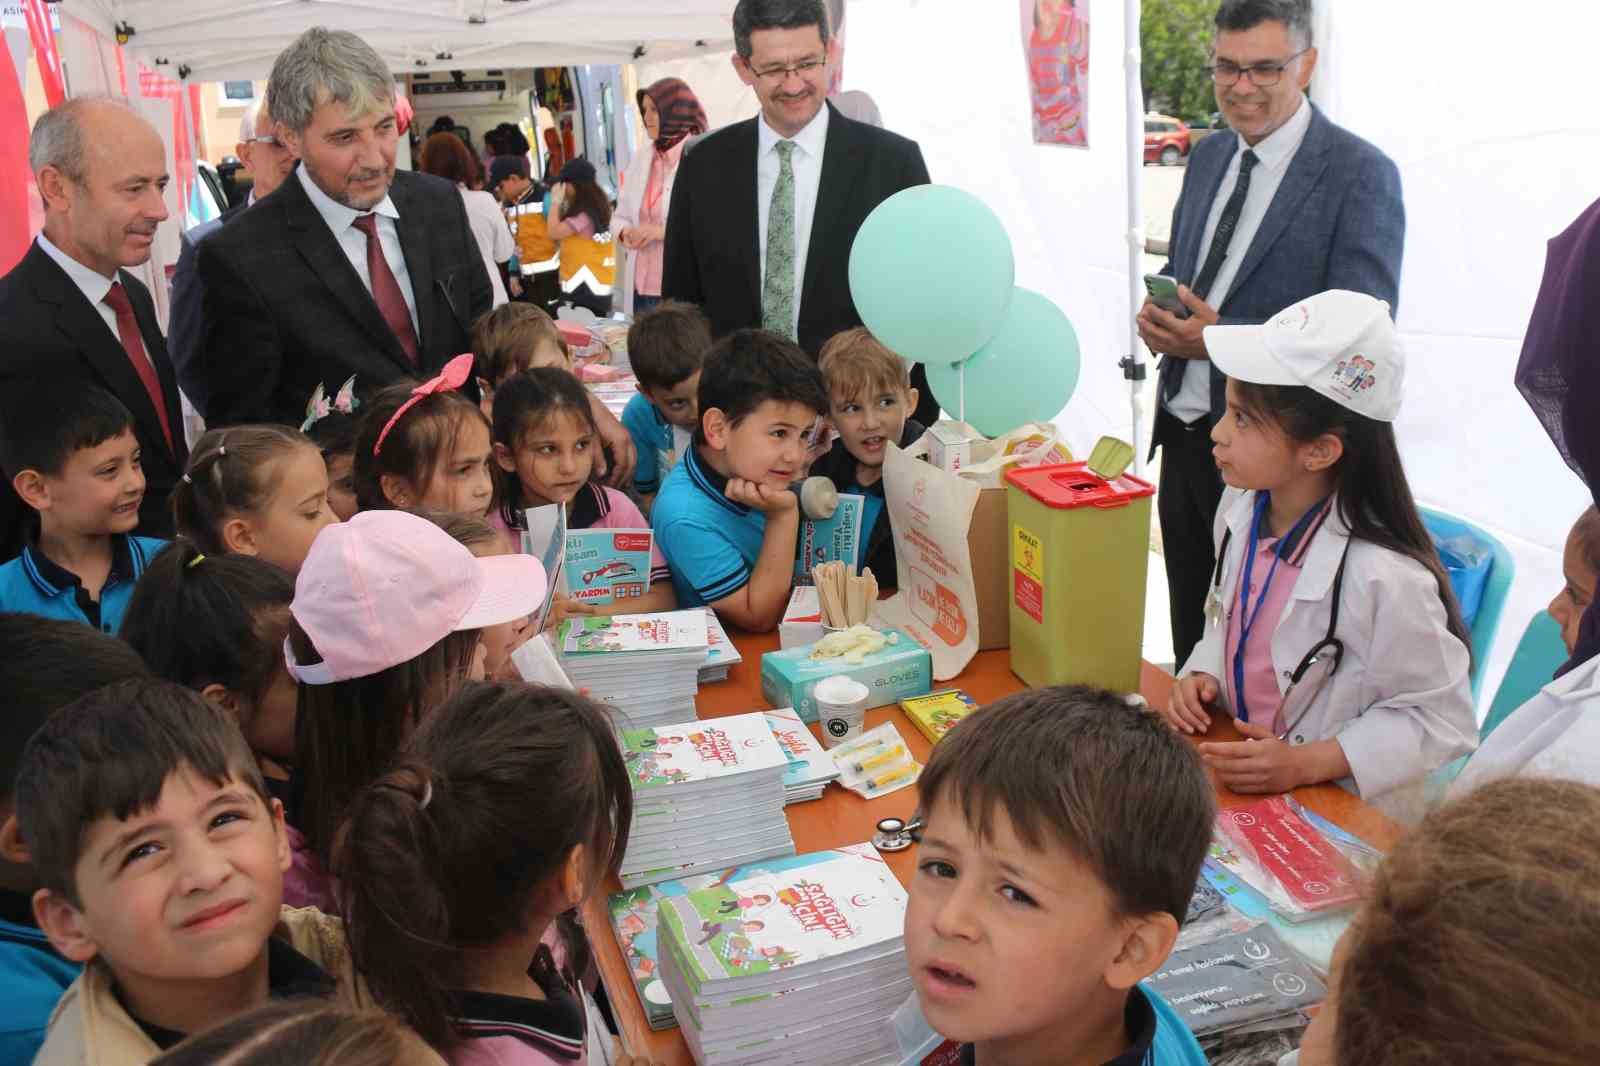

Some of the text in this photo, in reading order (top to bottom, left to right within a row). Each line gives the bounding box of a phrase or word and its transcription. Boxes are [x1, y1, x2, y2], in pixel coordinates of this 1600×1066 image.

[575, 588, 610, 599] YARDIM
[874, 670, 920, 687] GLOVES
[805, 883, 855, 939] SAĞLIĞIM
